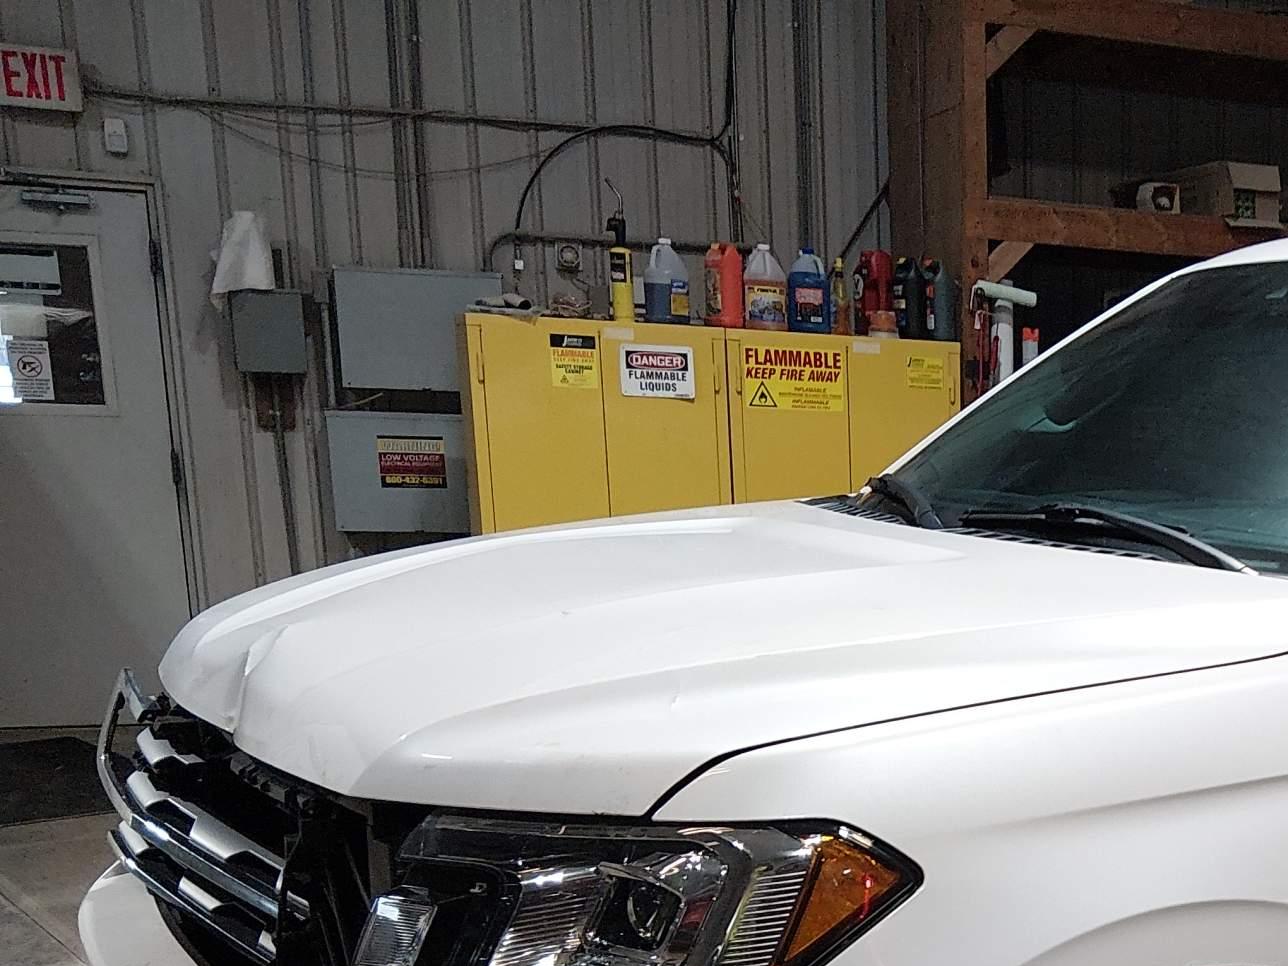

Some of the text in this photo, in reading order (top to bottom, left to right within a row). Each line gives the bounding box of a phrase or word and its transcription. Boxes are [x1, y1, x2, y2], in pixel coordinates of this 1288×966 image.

[1, 50, 66, 102] EXIT
[632, 353, 682, 368] DANGER
[745, 348, 842, 369] FLAMMABLE
[628, 370, 687, 382] FLAMMABLE
[745, 367, 840, 383] KEEP FIRE AWAY
[639, 382, 677, 393] LIQUIDS
